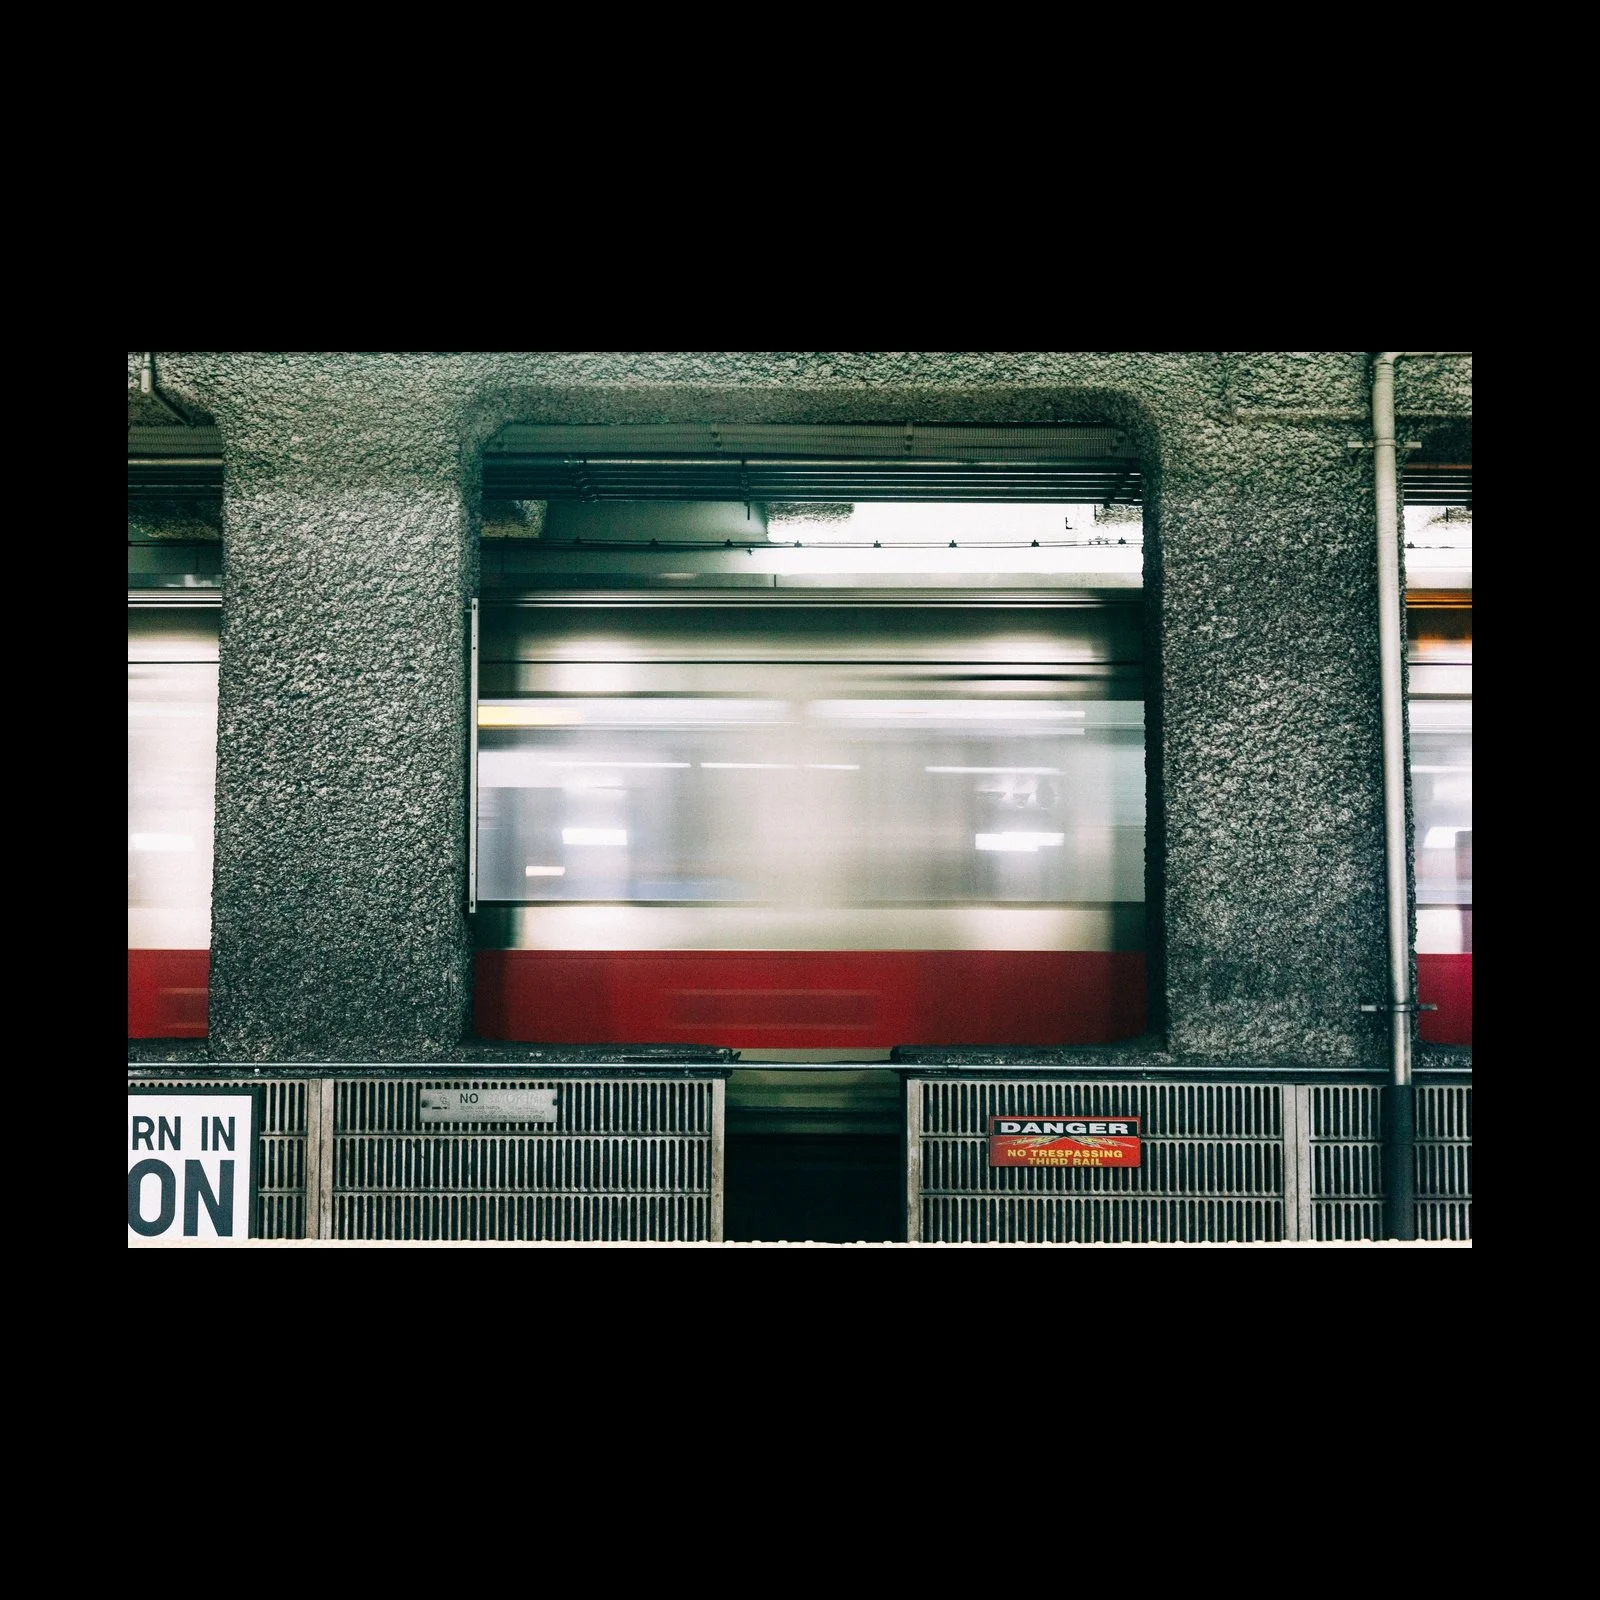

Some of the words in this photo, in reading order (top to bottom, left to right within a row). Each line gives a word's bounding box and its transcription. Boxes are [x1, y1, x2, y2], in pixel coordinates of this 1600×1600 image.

[459, 1093, 479, 1104] NO
[132, 1116, 181, 1150] RN
[201, 1116, 235, 1151] IN
[1000, 1122, 1129, 1134] DANGER
[1007, 1149, 1026, 1157] NO
[1031, 1149, 1123, 1158] TRESPASSING
[1028, 1157, 1068, 1166] THIRD
[1073, 1157, 1102, 1166] RAIL
[128, 1158, 235, 1237] ON
